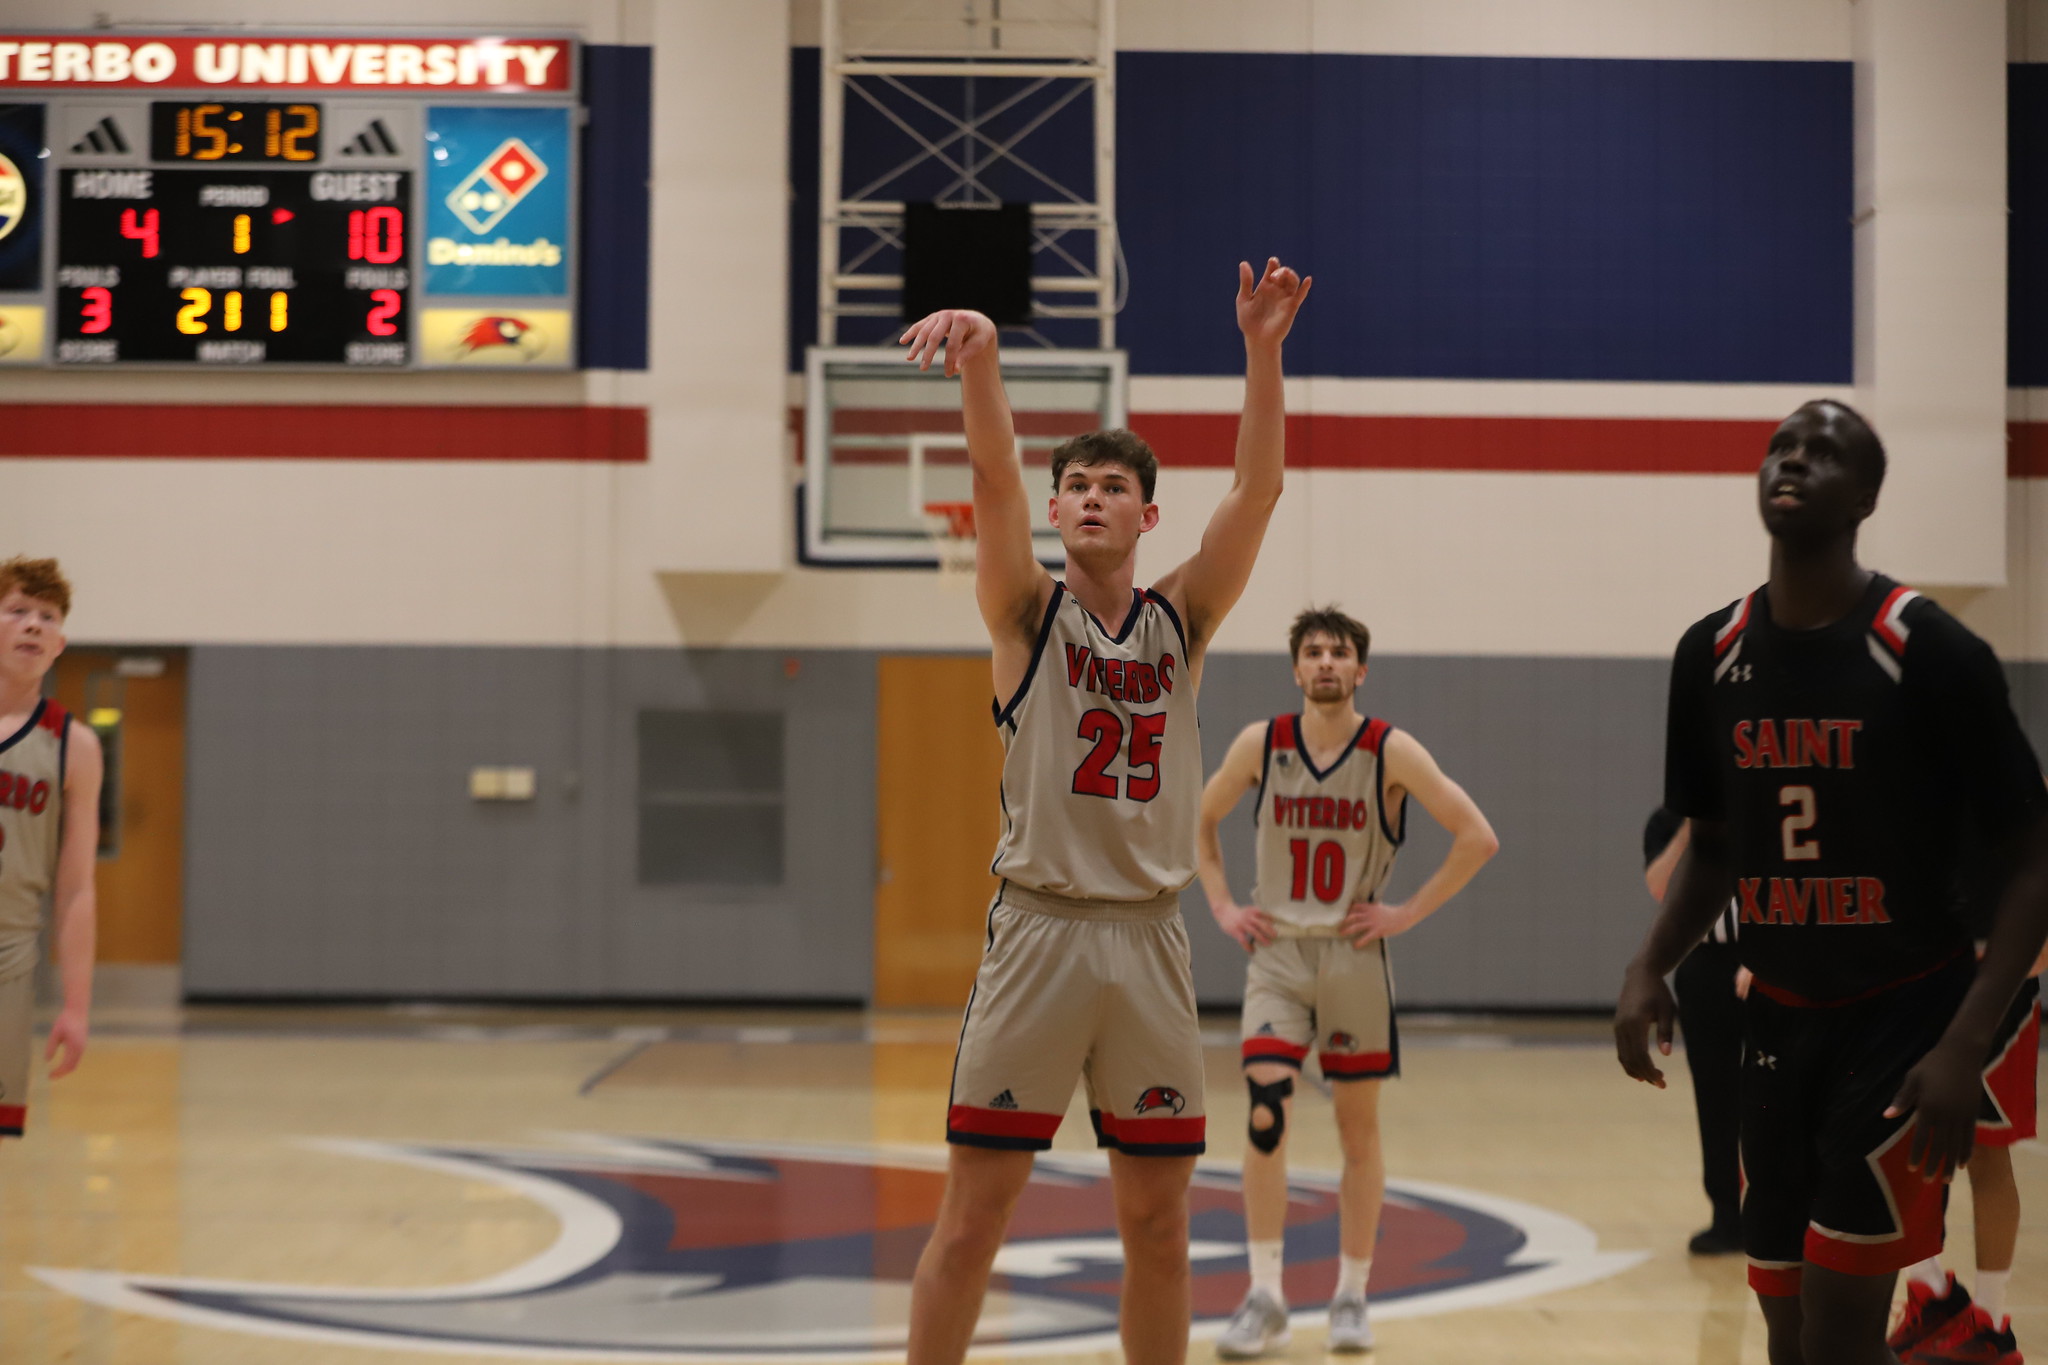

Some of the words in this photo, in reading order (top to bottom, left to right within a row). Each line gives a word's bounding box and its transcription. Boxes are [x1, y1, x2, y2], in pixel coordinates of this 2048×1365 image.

[193, 43, 560, 86] UNIVERSITY
[72, 172, 153, 199] HOME
[310, 172, 402, 201] GUEST
[119, 207, 160, 259] 4
[233, 213, 251, 255] 1
[348, 206, 404, 264] 10
[428, 237, 562, 267] Domino's
[80, 286, 112, 334] 3
[366, 289, 402, 336] 2
[1072, 708, 1167, 803] 25
[1734, 719, 1863, 769] SAINT
[1273, 795, 1368, 830] VITERBO
[1779, 785, 1820, 861] 2
[1289, 838, 1346, 904] 10
[1738, 877, 1893, 925] XAVIER
